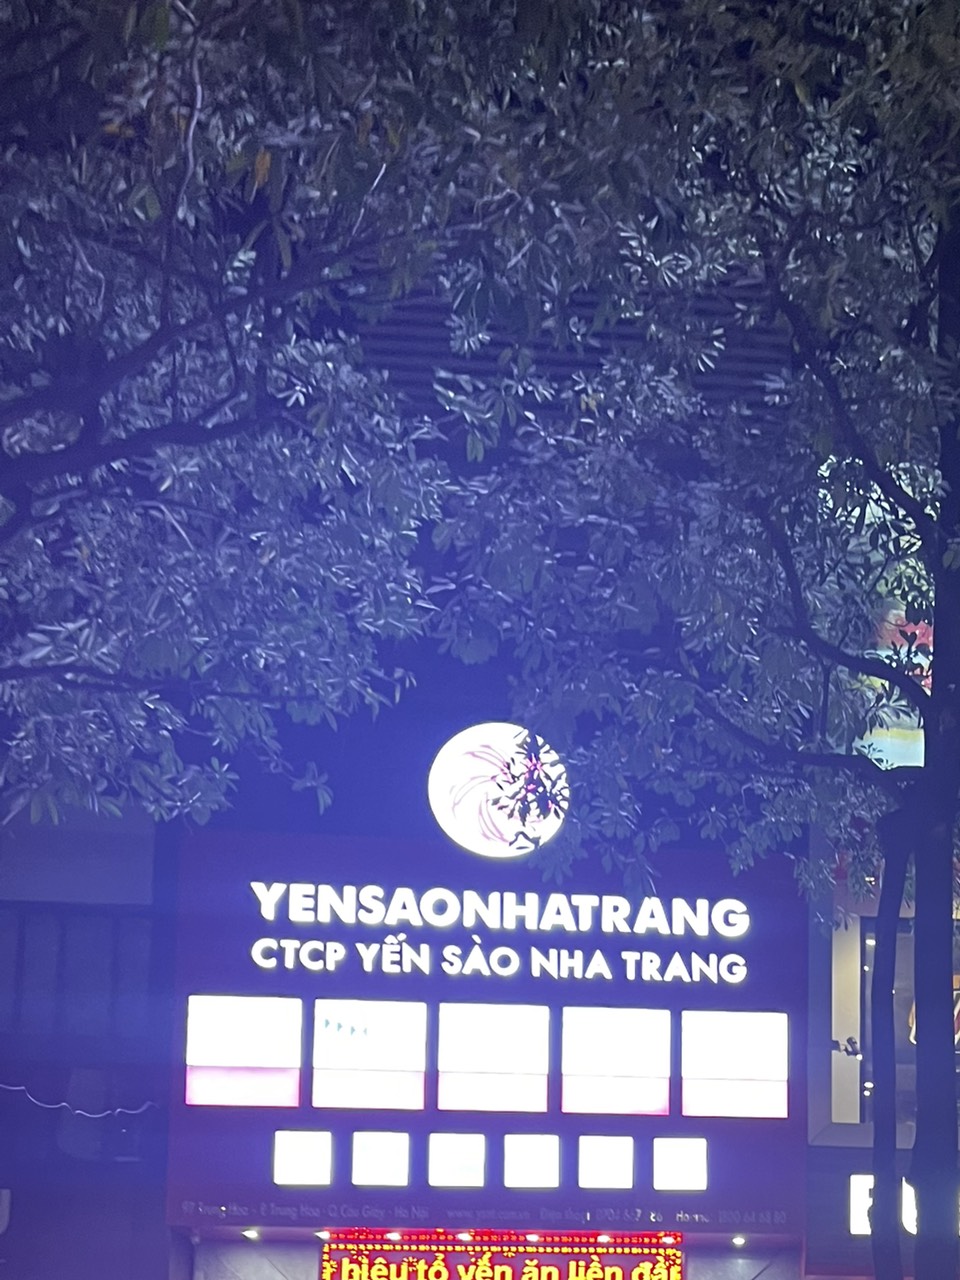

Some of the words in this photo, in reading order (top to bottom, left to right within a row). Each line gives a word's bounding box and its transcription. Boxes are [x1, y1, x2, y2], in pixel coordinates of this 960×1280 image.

[250, 881, 750, 937] YENSAONHATRANG
[251, 937, 346, 971] CTCP
[355, 932, 430, 975] YẾN
[441, 934, 520, 976] SÀO
[530, 946, 613, 980] NHA
[621, 951, 747, 984] TRANG
